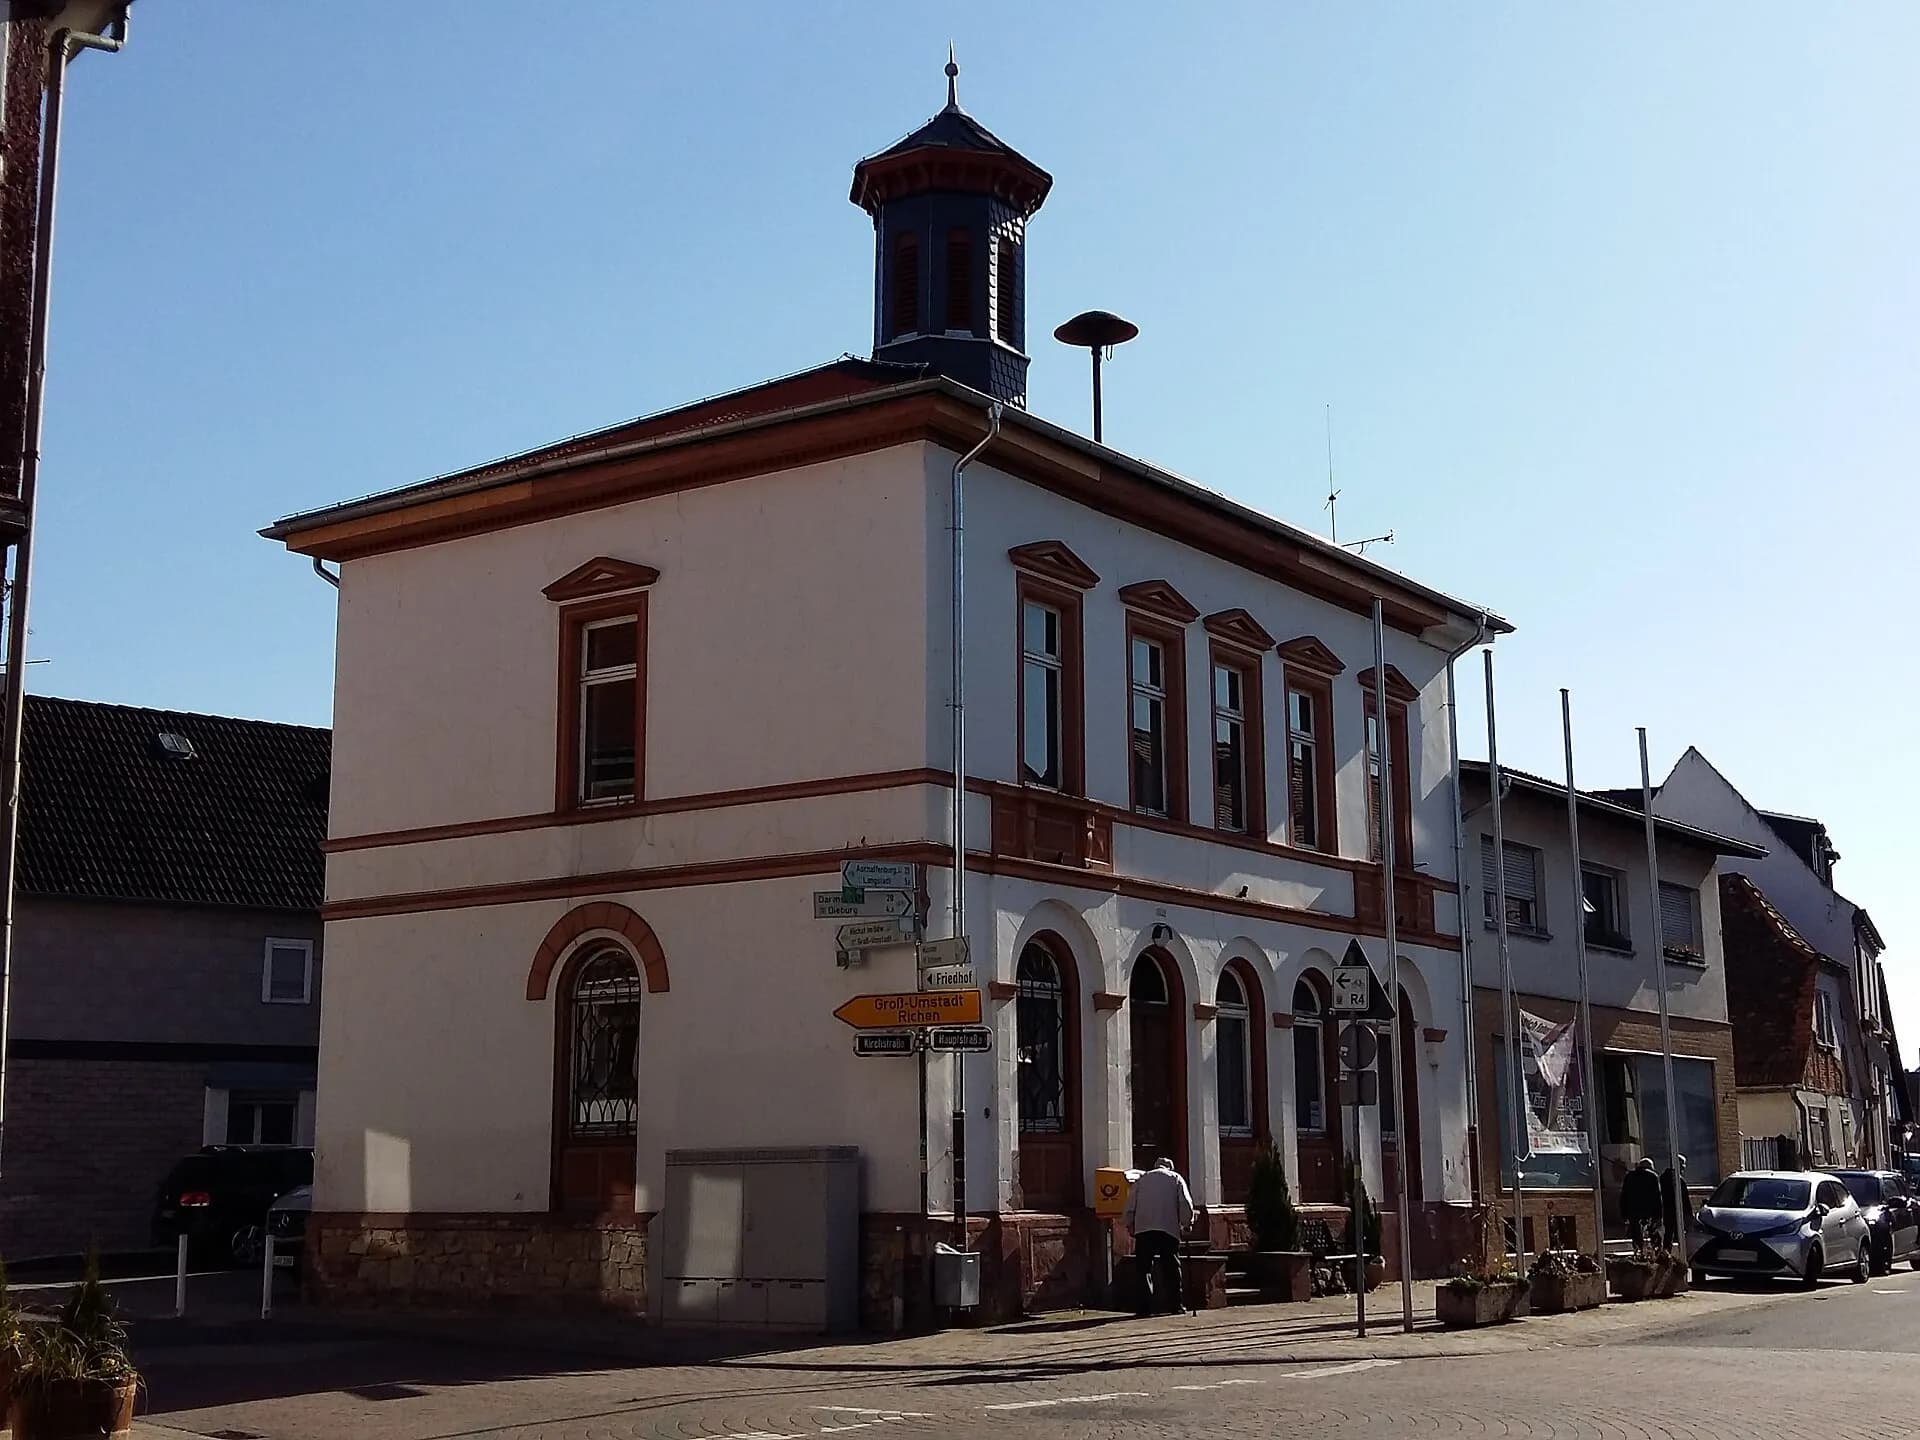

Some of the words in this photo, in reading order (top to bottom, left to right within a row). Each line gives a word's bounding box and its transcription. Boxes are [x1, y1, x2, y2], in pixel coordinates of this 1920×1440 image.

[828, 906, 858, 915] Dieburg
[936, 970, 973, 985] Friedhof
[874, 994, 964, 1010] Groß-Umstadt
[1350, 993, 1365, 1005] R4
[898, 1009, 940, 1023] Richen
[864, 1037, 905, 1049] Kirchstraße
[938, 1033, 982, 1045] Hauptstraße
